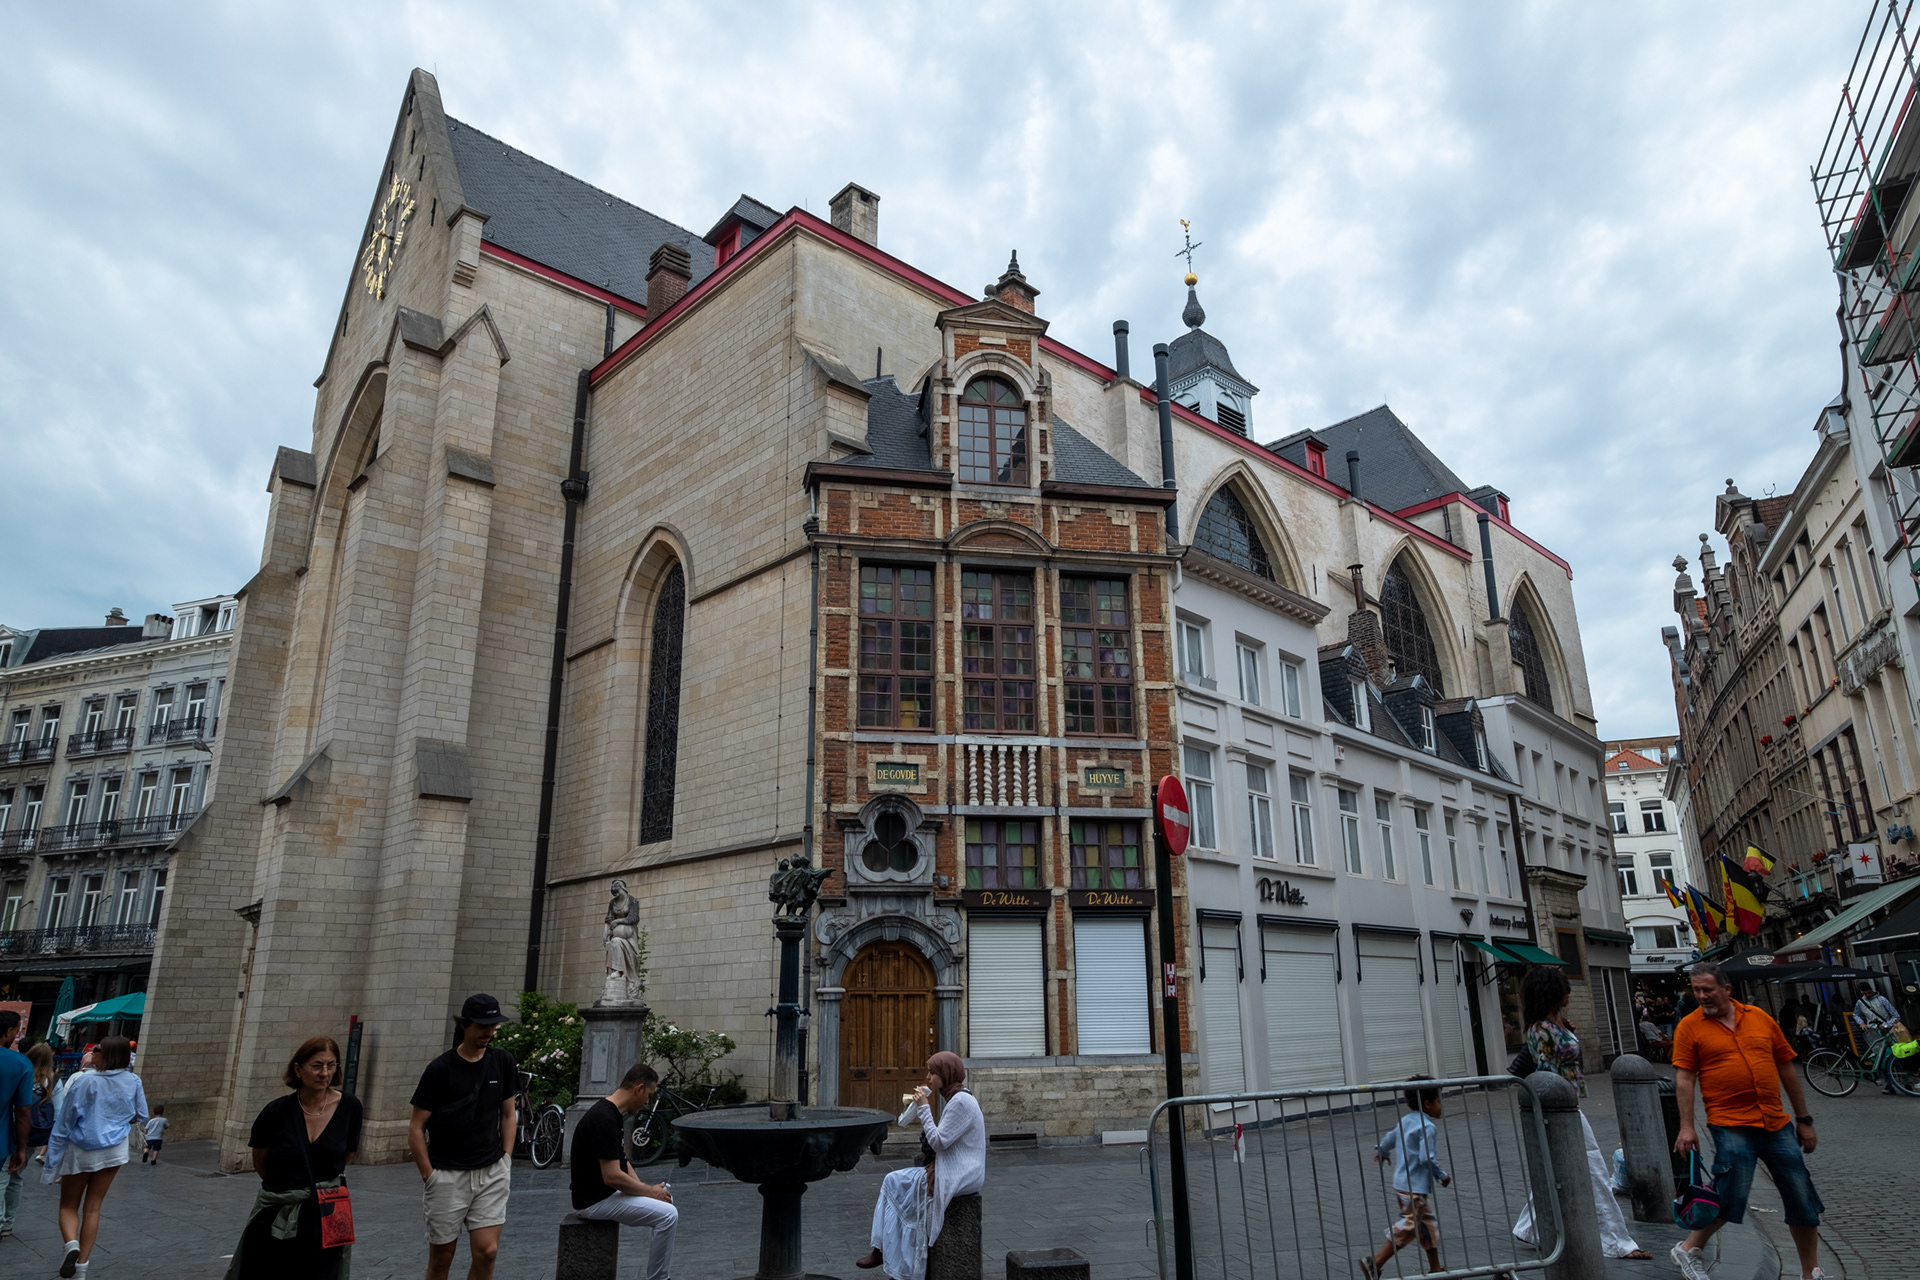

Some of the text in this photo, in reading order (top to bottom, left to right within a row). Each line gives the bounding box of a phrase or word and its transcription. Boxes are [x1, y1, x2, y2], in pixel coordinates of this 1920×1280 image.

[877, 769, 888, 780] DE
[1089, 773, 1120, 784] HUYVE
[1255, 877, 1306, 905] De Witte
[980, 891, 1030, 905] De Witte
[1085, 892, 1134, 905] De Witte
